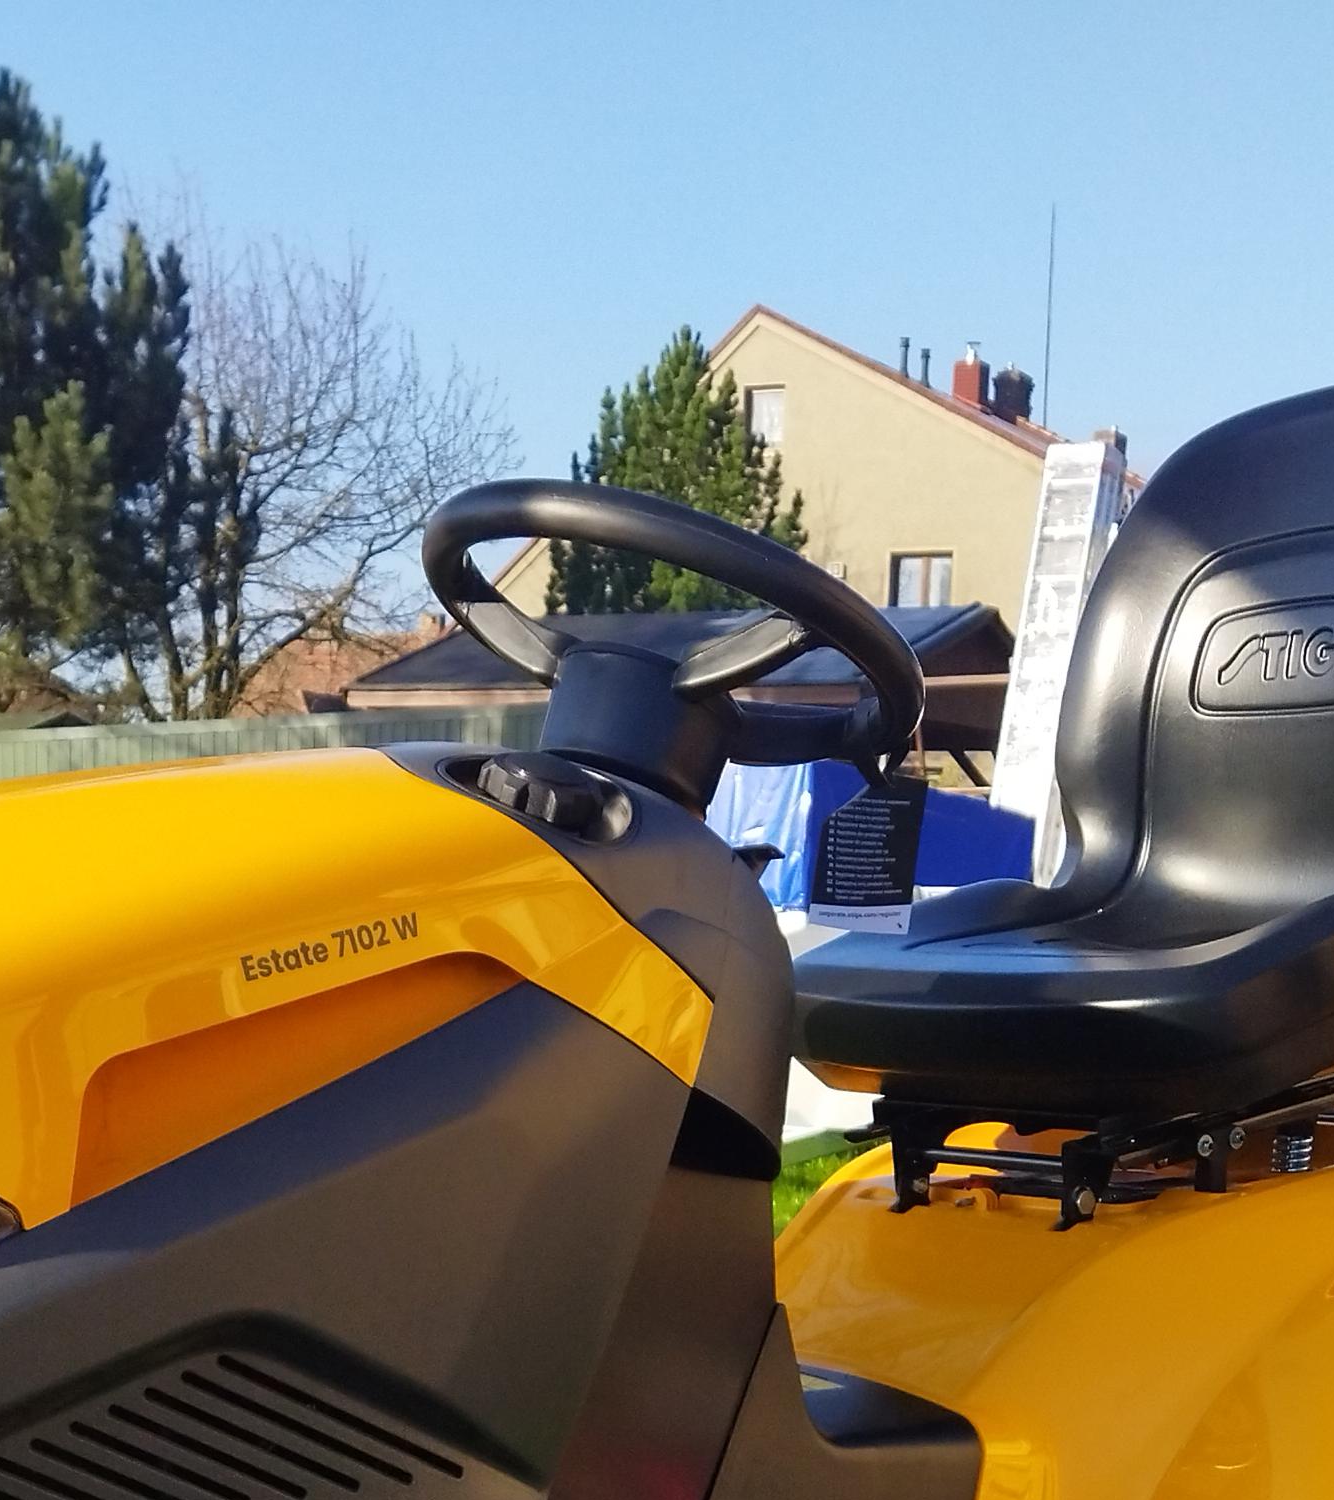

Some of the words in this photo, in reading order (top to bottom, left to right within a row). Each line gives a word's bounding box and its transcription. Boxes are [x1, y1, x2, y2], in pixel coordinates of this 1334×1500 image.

[240, 941, 329, 982] Estate
[331, 920, 391, 958] 7102
[391, 912, 418, 941] W
